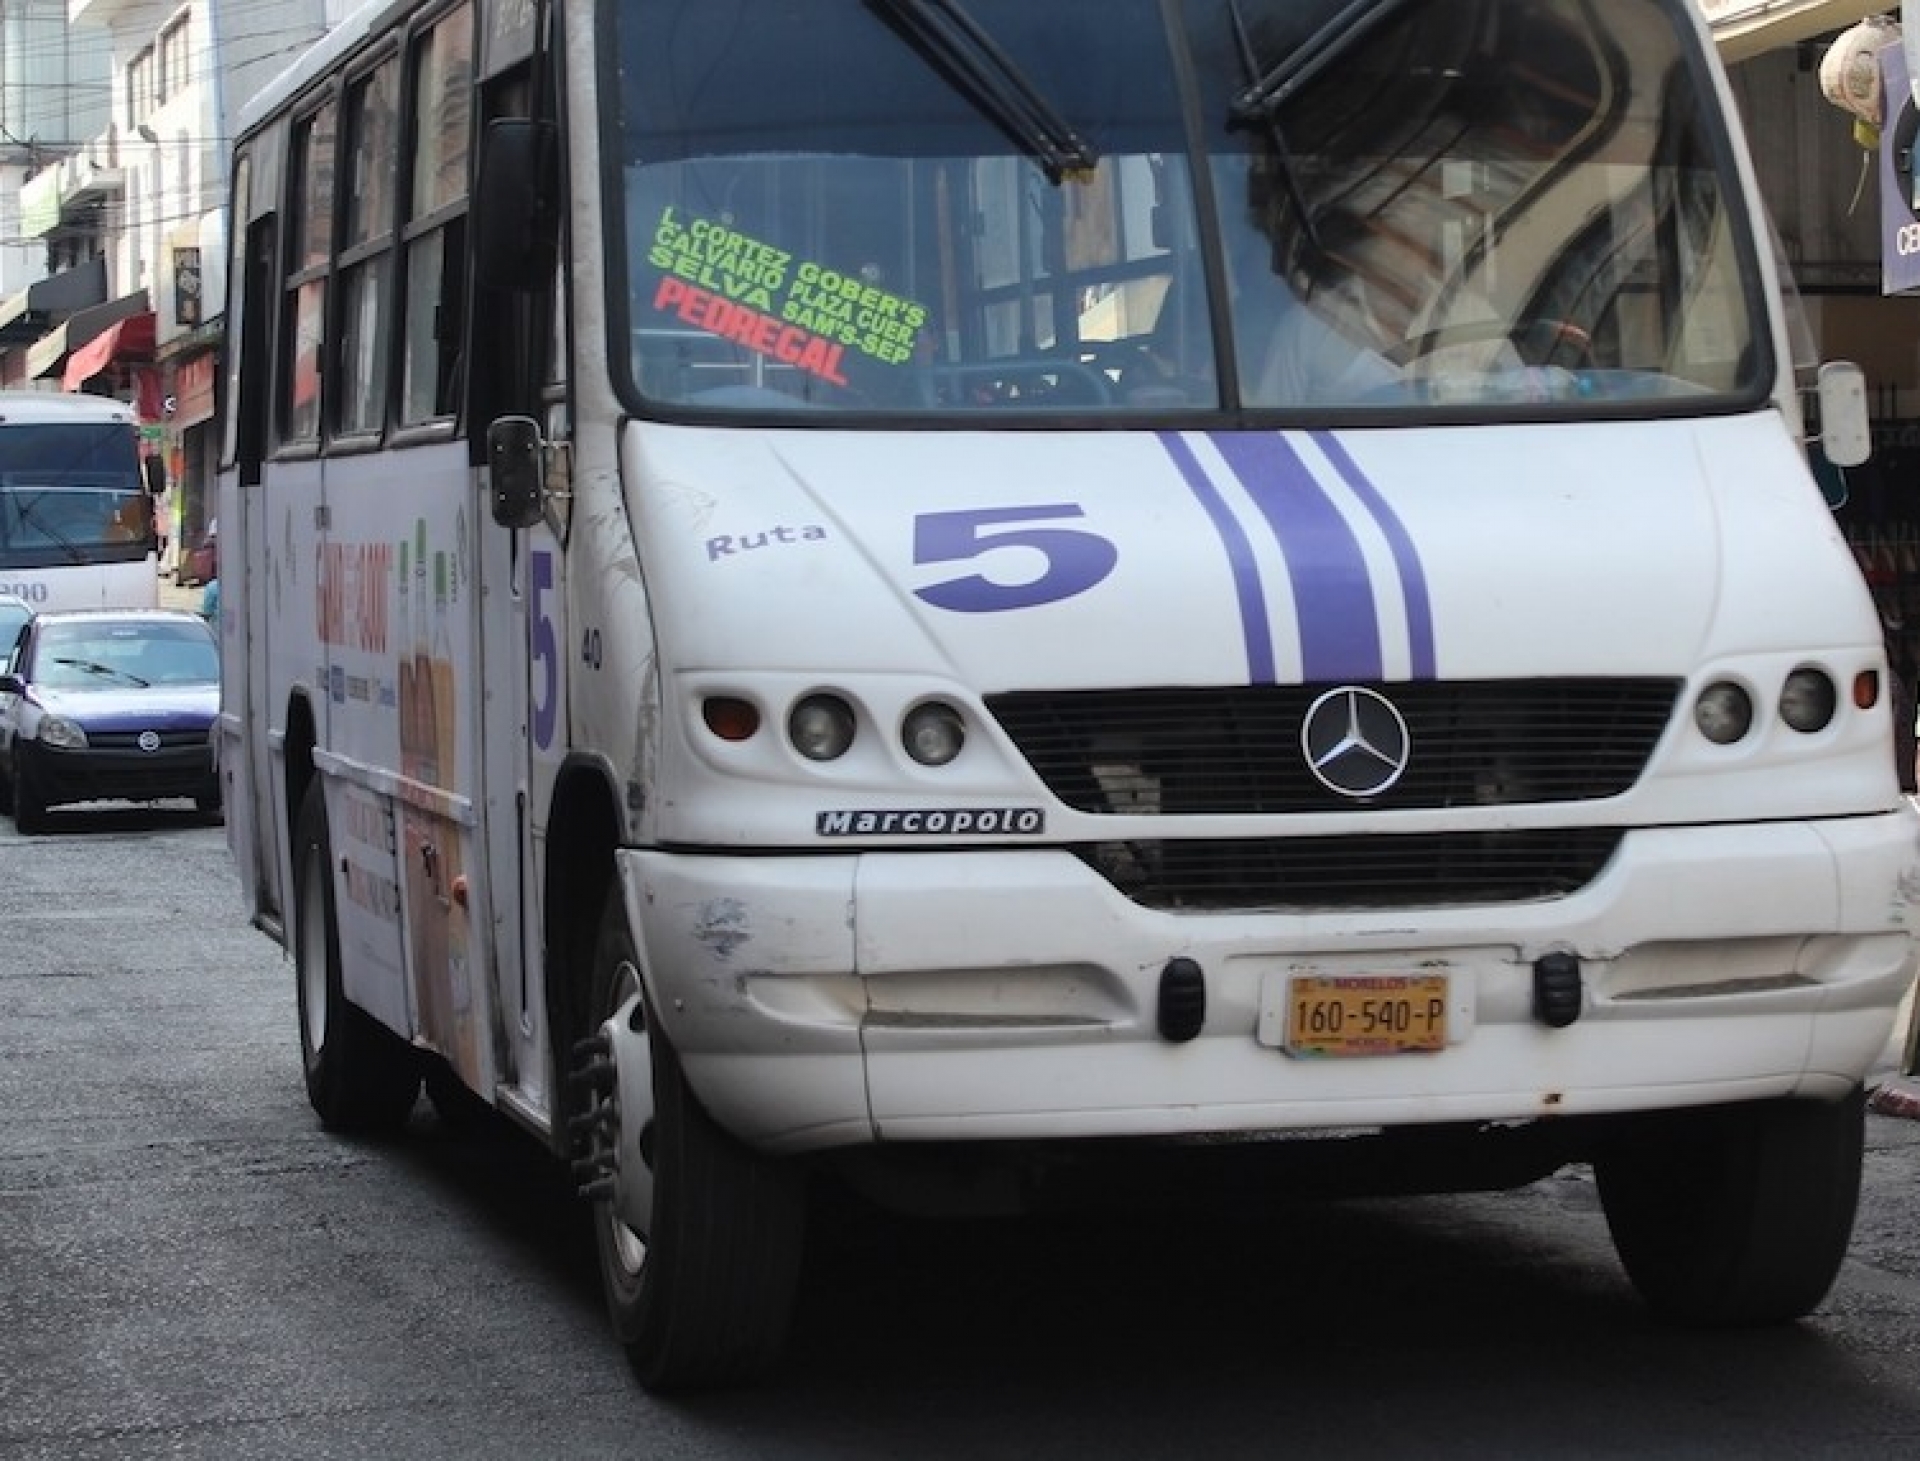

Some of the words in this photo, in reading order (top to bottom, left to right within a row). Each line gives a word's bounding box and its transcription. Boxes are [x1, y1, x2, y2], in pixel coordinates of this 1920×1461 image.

[648, 245, 771, 312] SELVA
[655, 226, 787, 289] CALVARIO
[788, 280, 852, 322] PLAZA
[691, 219, 791, 265] CORTEZ
[798, 262, 927, 327] GOBER'S
[653, 275, 848, 387] PEDREGAL
[705, 523, 827, 562] Ruta
[912, 503, 1118, 613] 5
[532, 550, 557, 751] 5
[821, 809, 1041, 834] Marcopolo
[1297, 998, 1444, 1034] 160-540-P
